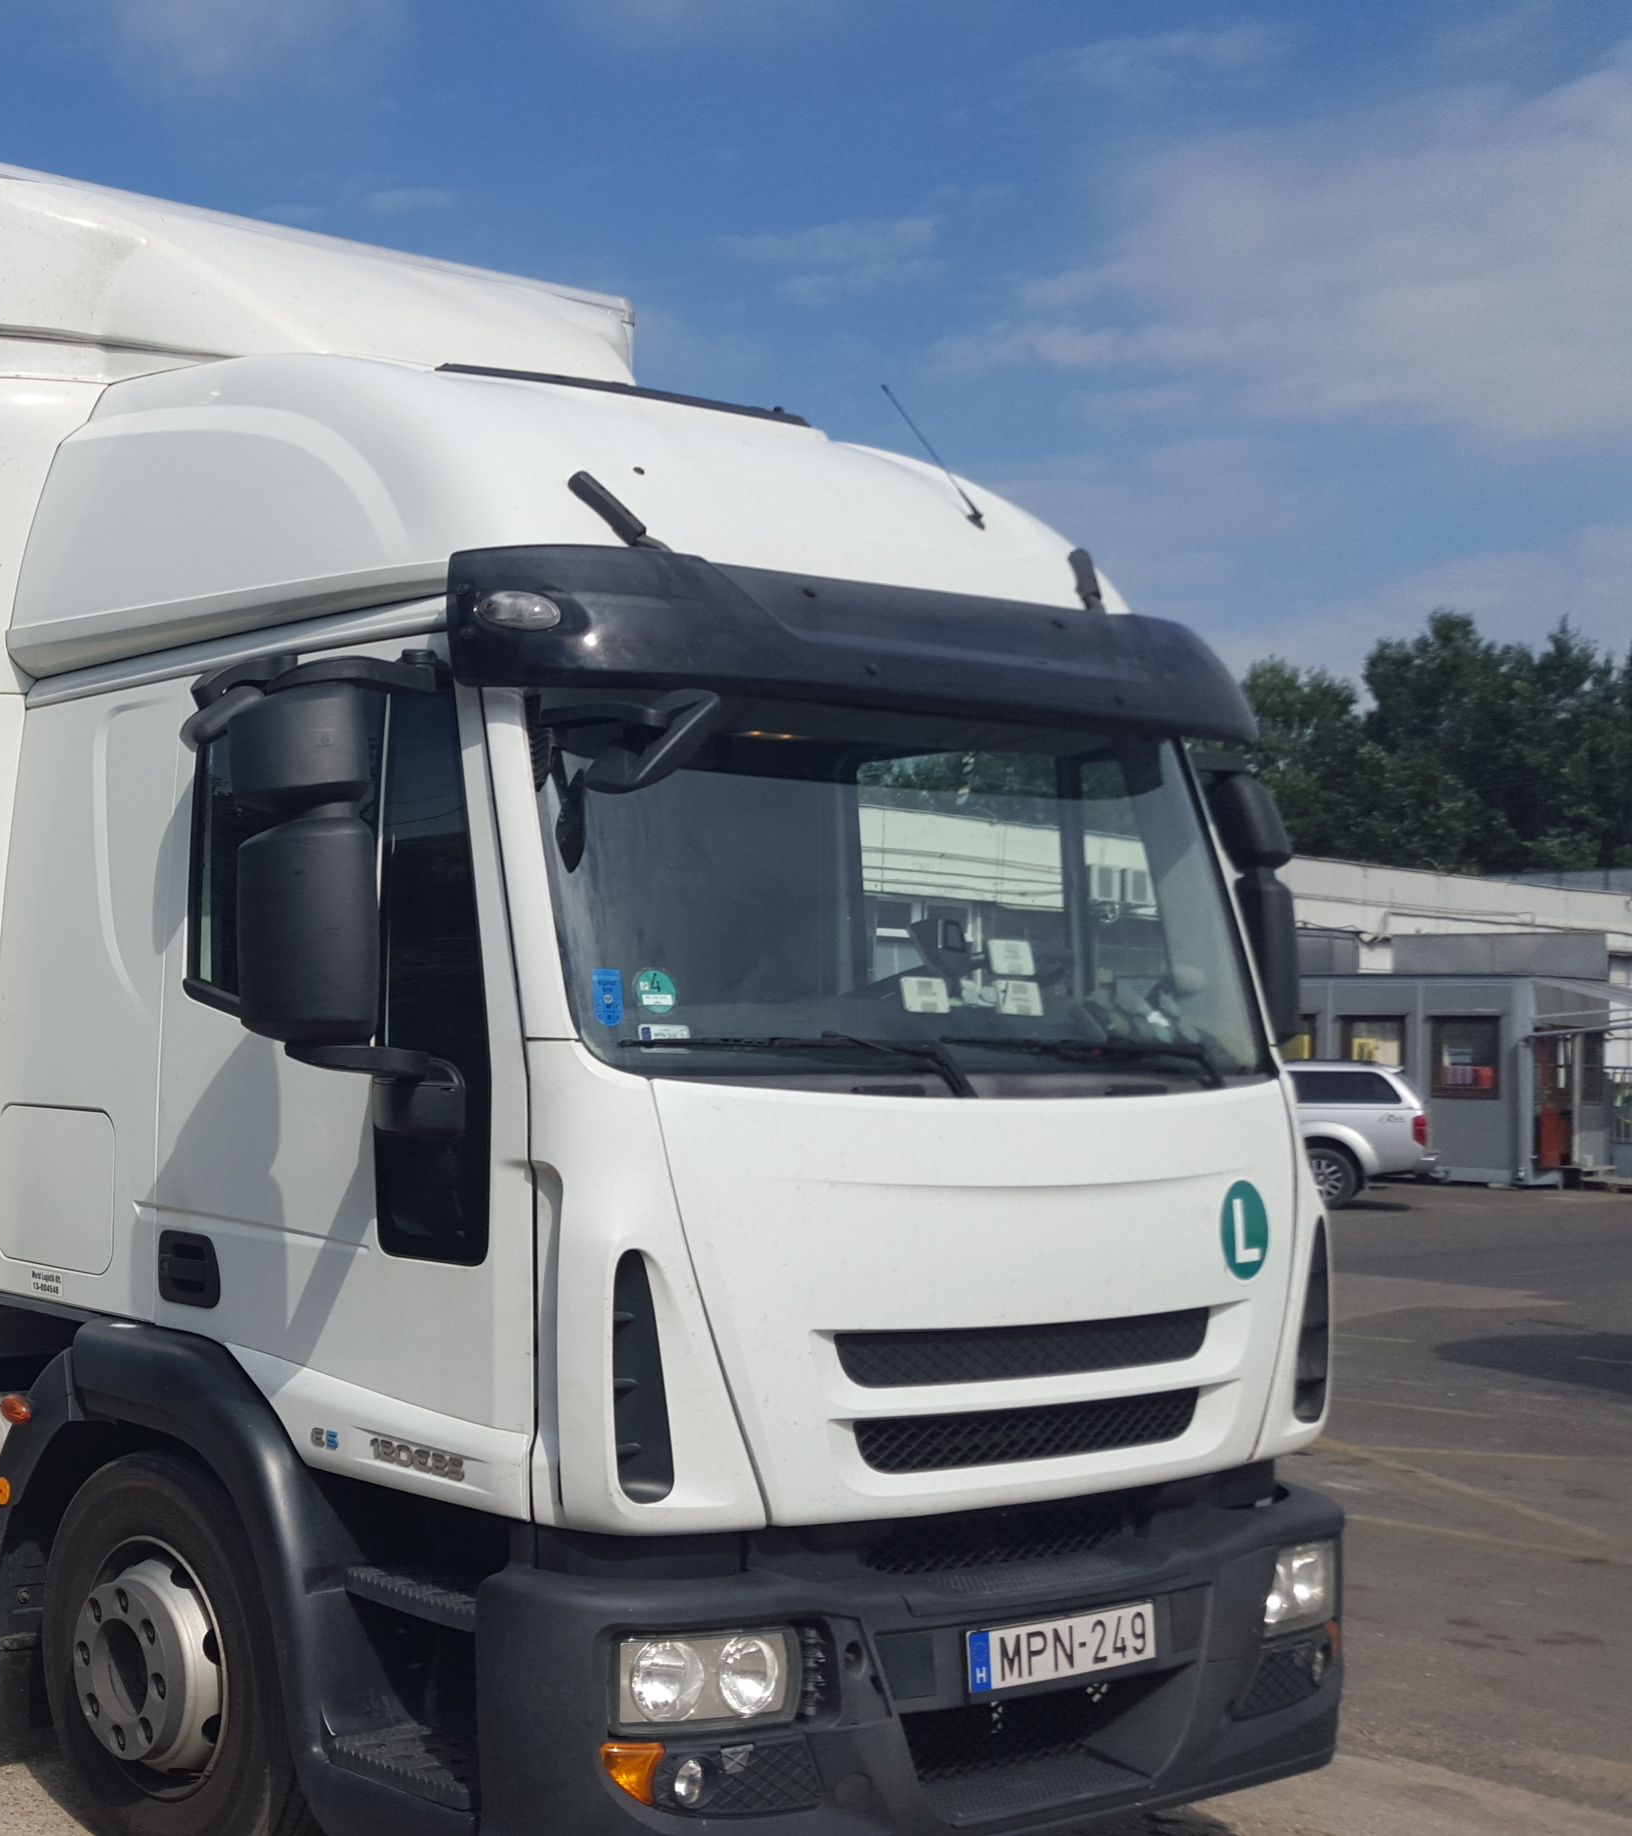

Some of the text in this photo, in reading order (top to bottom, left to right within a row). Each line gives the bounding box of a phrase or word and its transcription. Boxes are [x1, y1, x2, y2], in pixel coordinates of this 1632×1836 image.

[650, 972, 662, 993] 4
[1232, 1198, 1262, 1264] L
[975, 1611, 1147, 1684] H MPN-249
